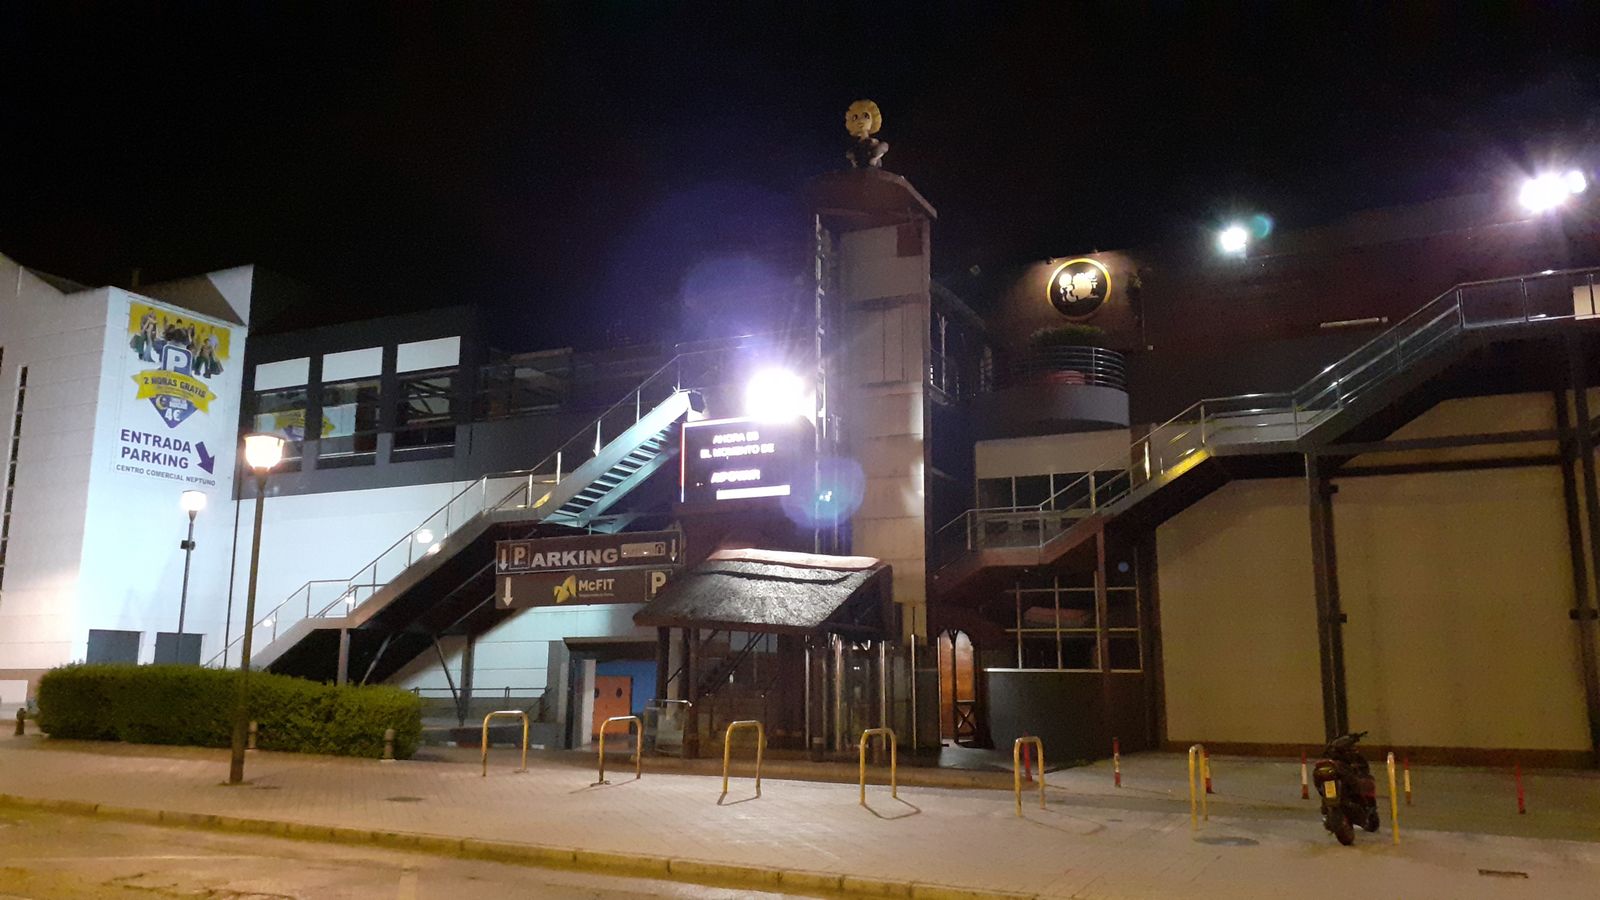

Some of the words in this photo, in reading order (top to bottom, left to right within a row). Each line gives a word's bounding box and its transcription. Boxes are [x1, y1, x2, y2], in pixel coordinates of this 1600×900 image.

[143, 376, 150, 385] 2
[179, 381, 207, 398] GRATIS
[120, 428, 191, 454] ENTRADA
[121, 446, 189, 469] PARKING
[115, 464, 145, 475] CENTRO
[145, 469, 184, 481] COMERCIAL
[185, 476, 216, 487] NEPTUNO
